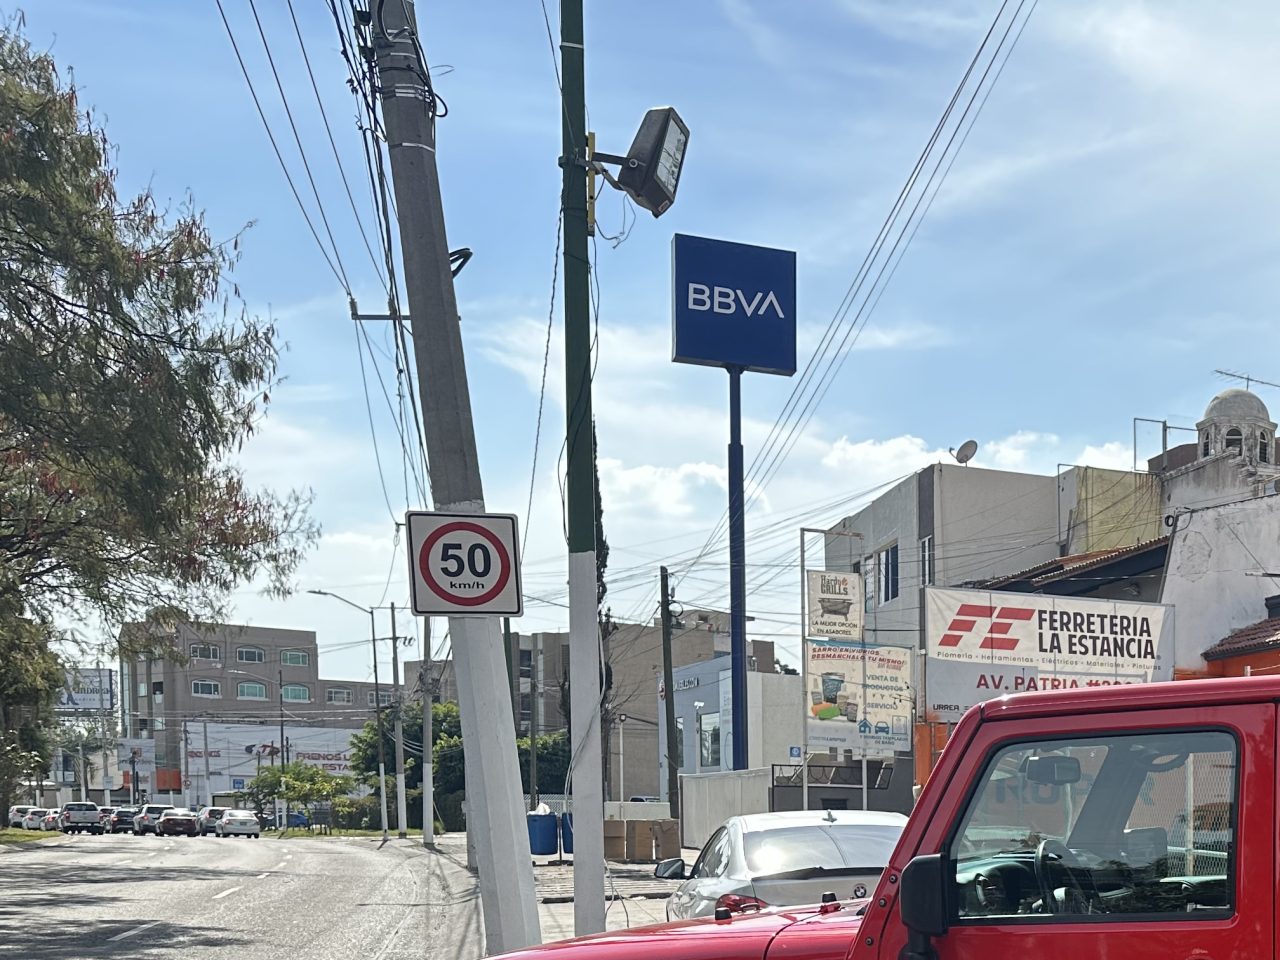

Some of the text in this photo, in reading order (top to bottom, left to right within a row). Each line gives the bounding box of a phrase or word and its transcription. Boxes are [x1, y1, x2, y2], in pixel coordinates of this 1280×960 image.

[687, 282, 785, 319] BBVA
[440, 542, 491, 578] 50
[449, 581, 485, 589] km/h
[1038, 609, 1152, 637] FERRETERIA
[1038, 631, 1156, 660] LA ESTANCIA
[981, 653, 1034, 663] Herramientas
[1132, 662, 1162, 671] Pinturas
[866, 674, 889, 682] VENTA
[976, 674, 1010, 691] AV.
[1014, 675, 1079, 692] PATRIA
[862, 684, 904, 692] PRODUCTOS
[867, 702, 898, 710] SERVICIO
[932, 703, 960, 711] URREA
